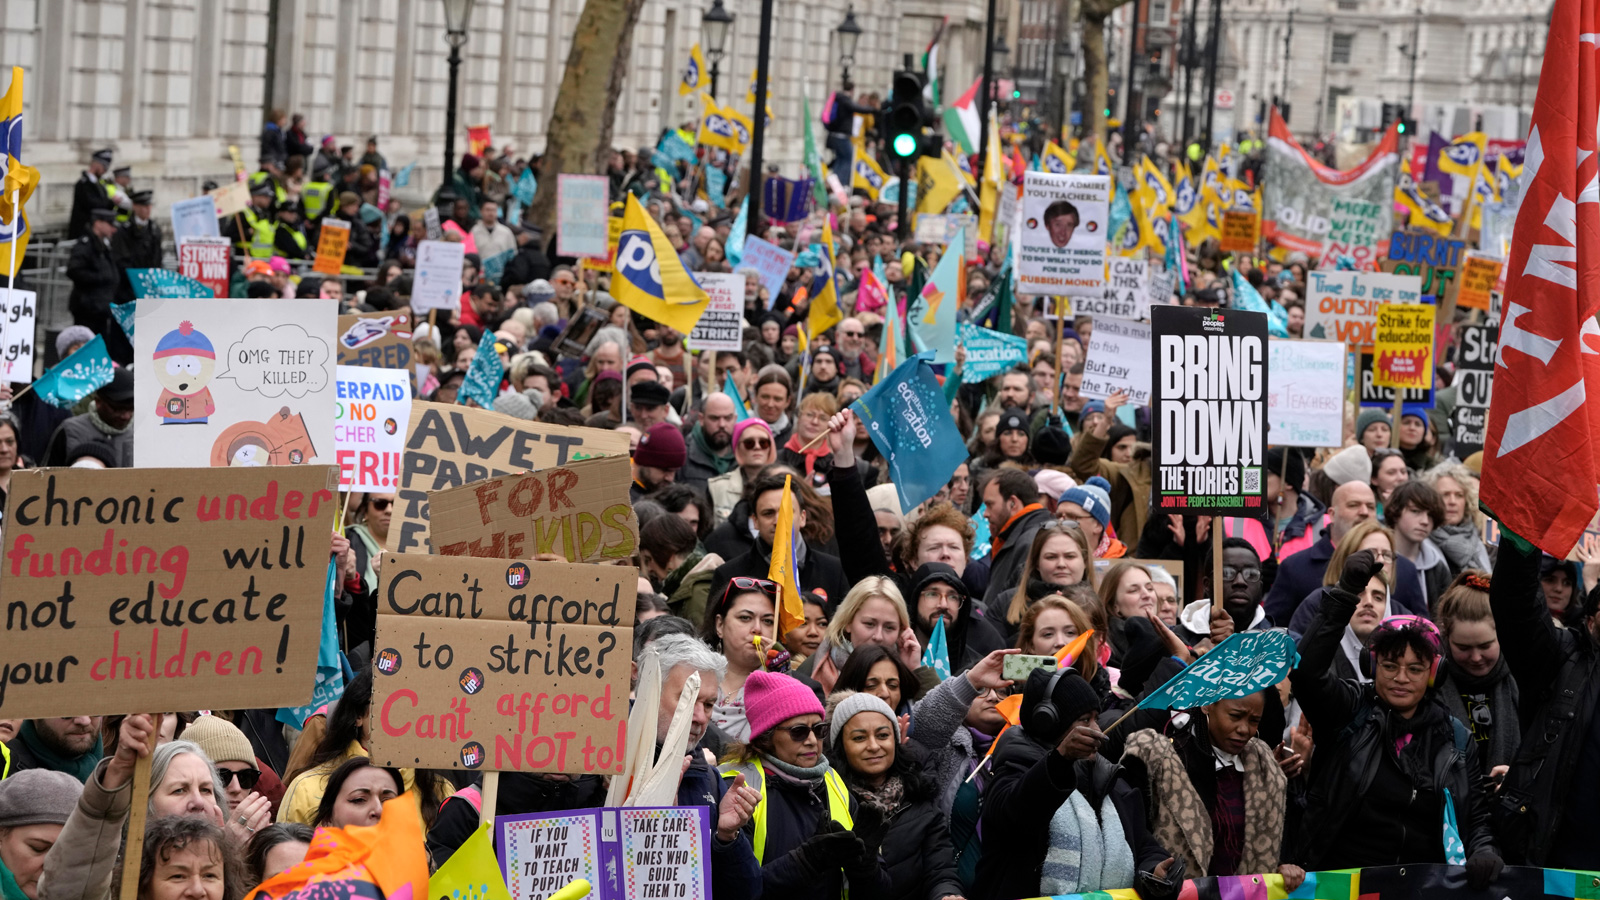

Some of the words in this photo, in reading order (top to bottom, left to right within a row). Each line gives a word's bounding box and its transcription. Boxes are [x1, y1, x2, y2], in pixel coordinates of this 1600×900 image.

[1032, 178, 1067, 188] REALLY
[1069, 181, 1106, 190] ADMIRE
[1027, 190, 1047, 198] YOU
[1331, 218, 1375, 234] WITH
[1328, 232, 1371, 246] LESS
[182, 246, 227, 263] STRIKE
[1389, 231, 1465, 266] BURNT
[1047, 256, 1070, 264] WHAT
[182, 262, 200, 278] TO
[202, 263, 227, 280] WIN
[1114, 262, 1144, 275] CAN
[1020, 275, 1062, 285] RUBBISH
[1065, 278, 1101, 287] MONEY
[1310, 273, 1343, 295] Time
[1352, 276, 1366, 296] to
[1126, 291, 1135, 302] A
[1094, 320, 1120, 335] Teach
[1122, 326, 1128, 335] a
[1380, 314, 1412, 328] Strike
[1416, 315, 1432, 328] for
[691, 328, 738, 340] STRIKE
[1378, 330, 1431, 344] education
[1090, 340, 1100, 350] to
[1102, 341, 1120, 354] fish
[239, 350, 270, 365] OMG
[279, 349, 314, 365] THEY
[1086, 360, 1106, 373] But
[1108, 366, 1130, 379] pay
[1160, 335, 1262, 400] BRING
[1082, 378, 1100, 393] the
[350, 402, 376, 422] NO
[1160, 400, 1262, 466] DOWN
[402, 451, 510, 490] PAR
[1160, 466, 1184, 490] THE
[1186, 466, 1238, 495] TORIES
[15, 475, 184, 526] chronic
[196, 480, 332, 522] under
[474, 468, 578, 526] FOR
[1160, 496, 1176, 508] JOIN
[1176, 496, 1188, 507] THE
[1188, 496, 1216, 508] PEOPLE'S
[1216, 496, 1244, 508] ASSEMBLY
[1244, 496, 1262, 508] TODAY
[440, 531, 525, 560] THE
[532, 504, 636, 564] KIDS
[7, 528, 190, 600] funding
[223, 525, 306, 570] will
[508, 566, 525, 576] PAY
[6, 580, 76, 630] not
[109, 575, 288, 627] educate
[388, 570, 484, 620] Can't
[508, 583, 620, 641] afford
[380, 651, 397, 661] PAY
[414, 632, 454, 670] to
[487, 631, 616, 679] strike?
[460, 670, 475, 688] PAY
[380, 688, 473, 742] Can't
[496, 684, 616, 736] afford
[462, 744, 478, 755] PAY
[494, 732, 576, 772] NOT
[581, 720, 626, 772] to!
[634, 819, 659, 832] TAKE
[662, 818, 688, 832] CARE
[530, 828, 542, 843] IF
[546, 826, 568, 841] YOU
[644, 836, 658, 849] OF
[660, 834, 679, 848] THE
[534, 843, 568, 859] WANT
[636, 852, 664, 866] ONES
[666, 850, 688, 864] WHO
[524, 862, 542, 876] TO
[544, 858, 580, 874] TEACH
[648, 868, 678, 882] GUIDE
[643, 884, 670, 898] THEM
[674, 883, 686, 897] TO
